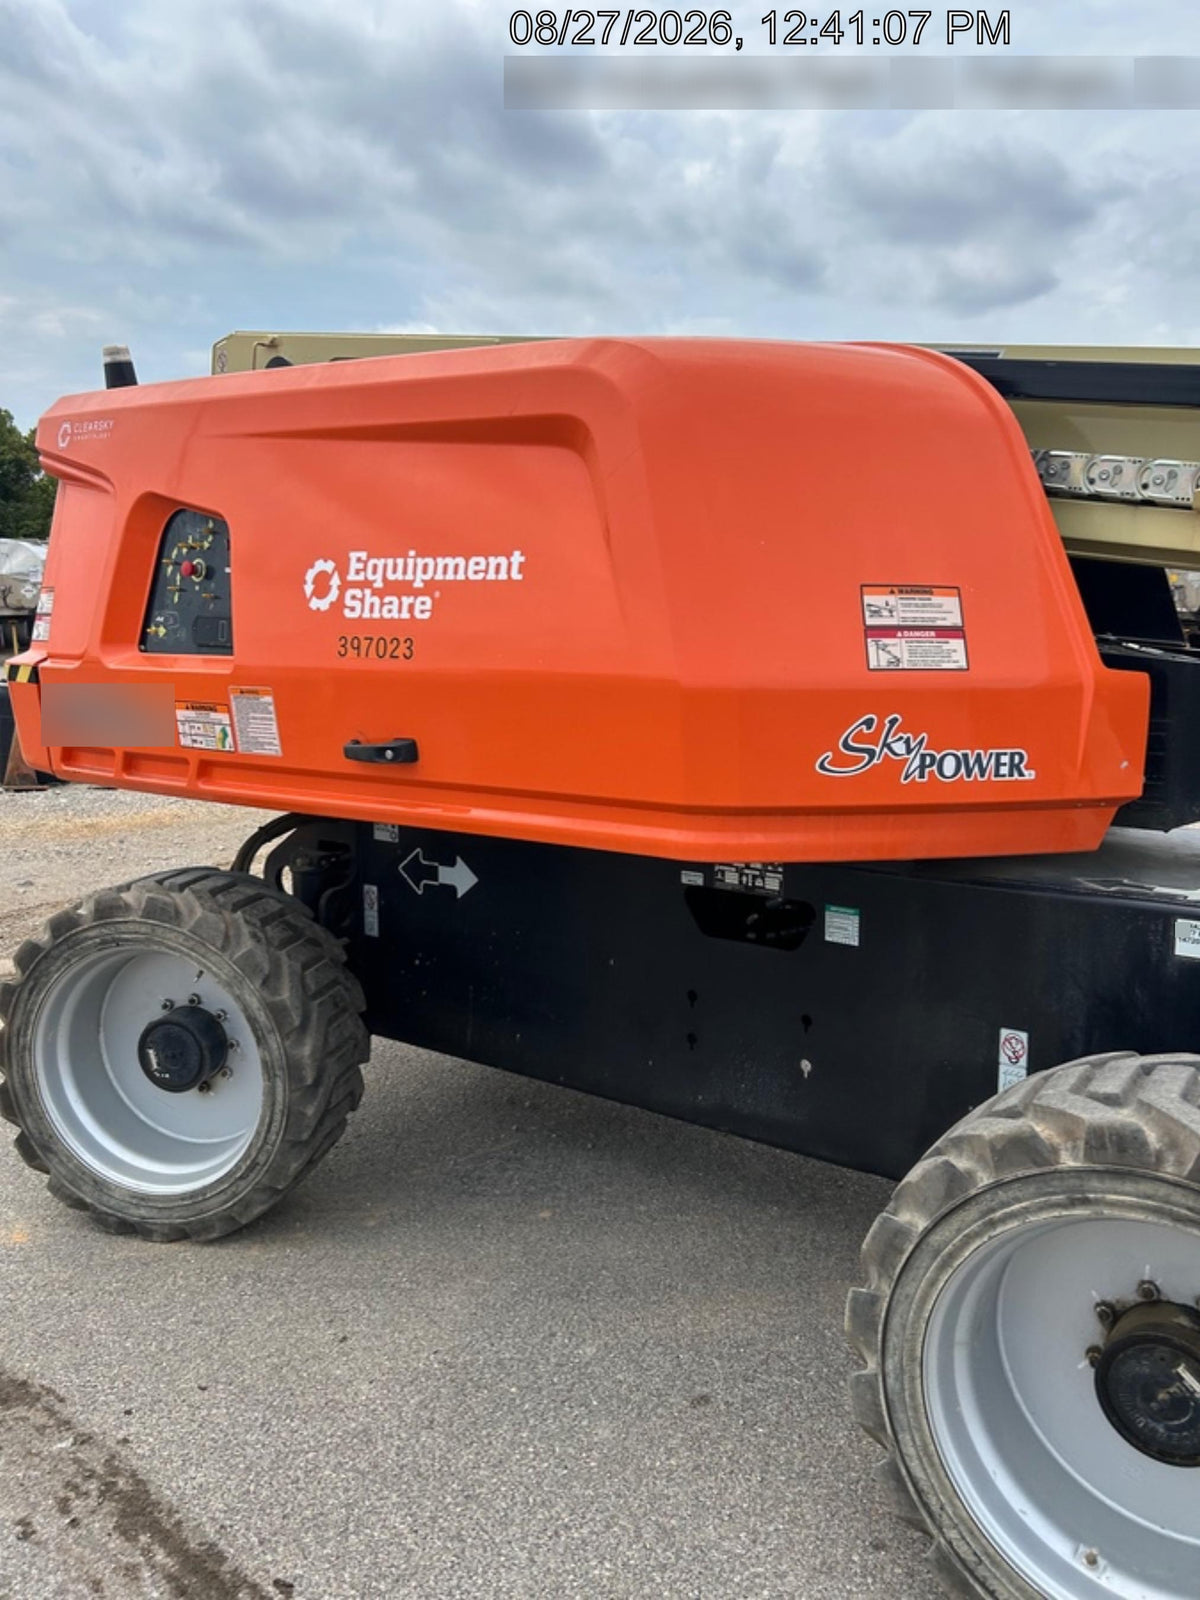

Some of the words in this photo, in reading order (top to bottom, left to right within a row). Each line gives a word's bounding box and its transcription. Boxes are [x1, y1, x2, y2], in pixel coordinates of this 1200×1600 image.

[73, 419, 114, 433] CLEARSKY
[346, 549, 526, 588] Equipment
[897, 588, 934, 596] WARNING
[343, 587, 433, 620] Share
[902, 630, 936, 639] DANGER
[337, 634, 415, 661] 397023
